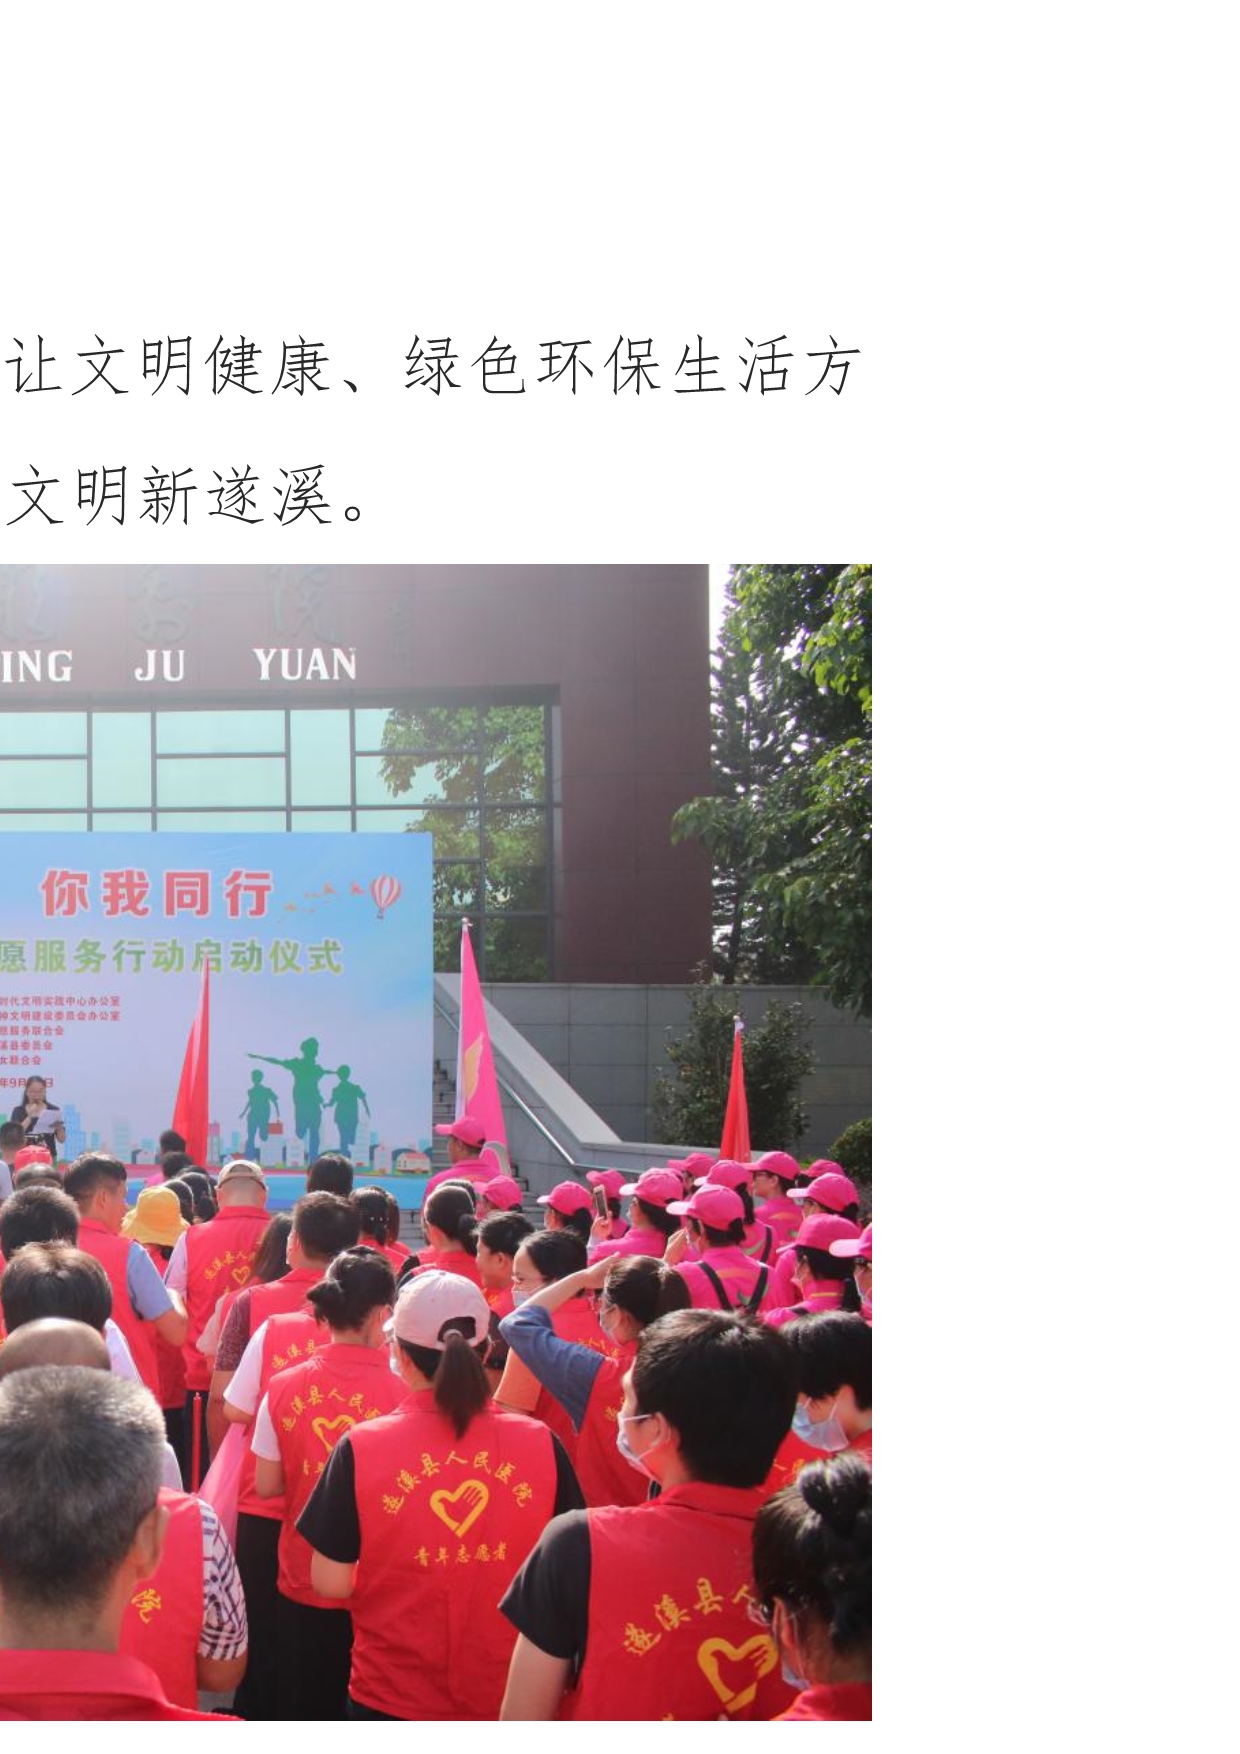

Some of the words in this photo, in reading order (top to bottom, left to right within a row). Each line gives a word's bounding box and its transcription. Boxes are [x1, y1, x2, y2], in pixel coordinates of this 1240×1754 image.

[135, 648, 185, 681] JU
[253, 647, 356, 681] YUAN
[41, 869, 274, 919] 你我同行
[382, 1450, 534, 1515] 遂溪县人民医院
[414, 1541, 509, 1568] 青年志愿者
